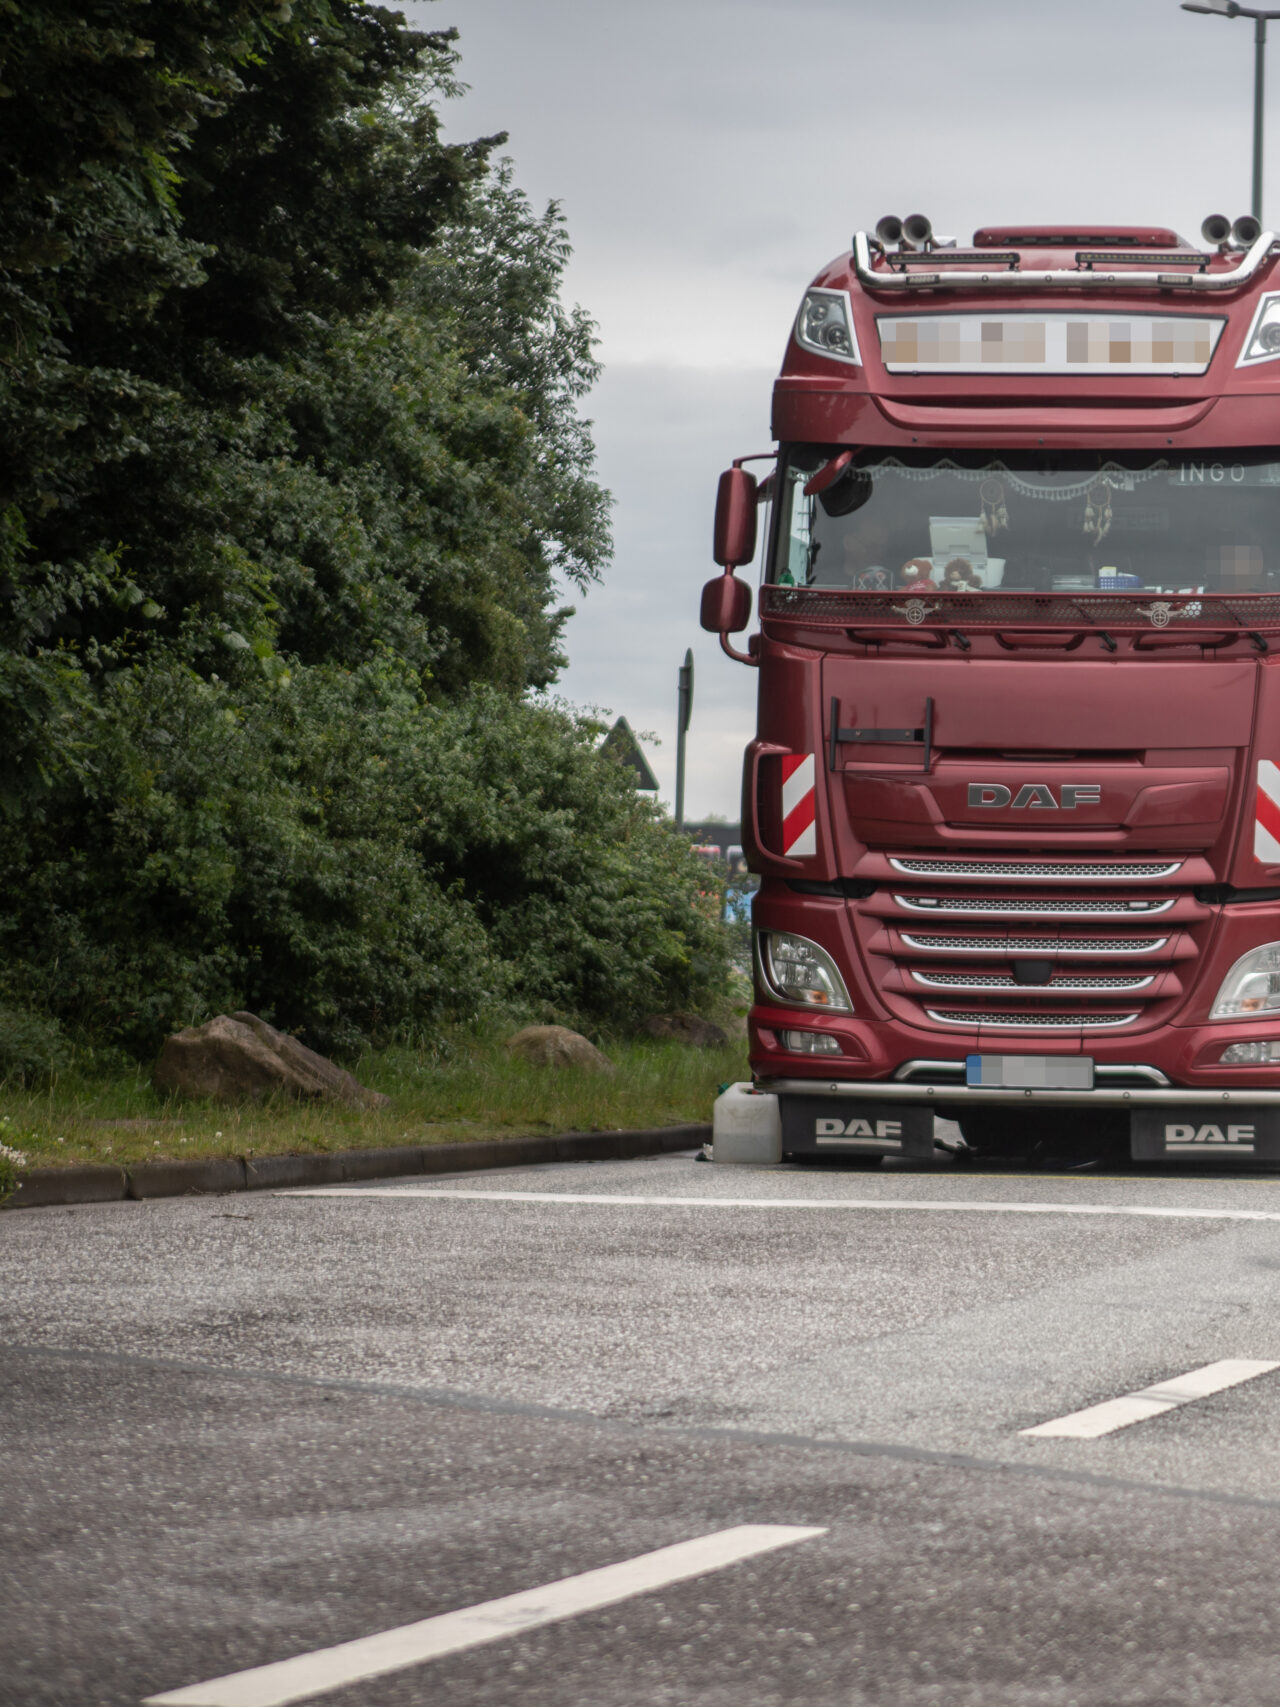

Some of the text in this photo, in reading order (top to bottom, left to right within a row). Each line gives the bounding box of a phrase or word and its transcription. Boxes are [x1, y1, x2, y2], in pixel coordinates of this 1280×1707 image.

[1179, 462, 1245, 482] INGO
[967, 783, 1101, 809] DAF
[815, 1118, 903, 1137] DAF
[1165, 1124, 1255, 1142] DAF
